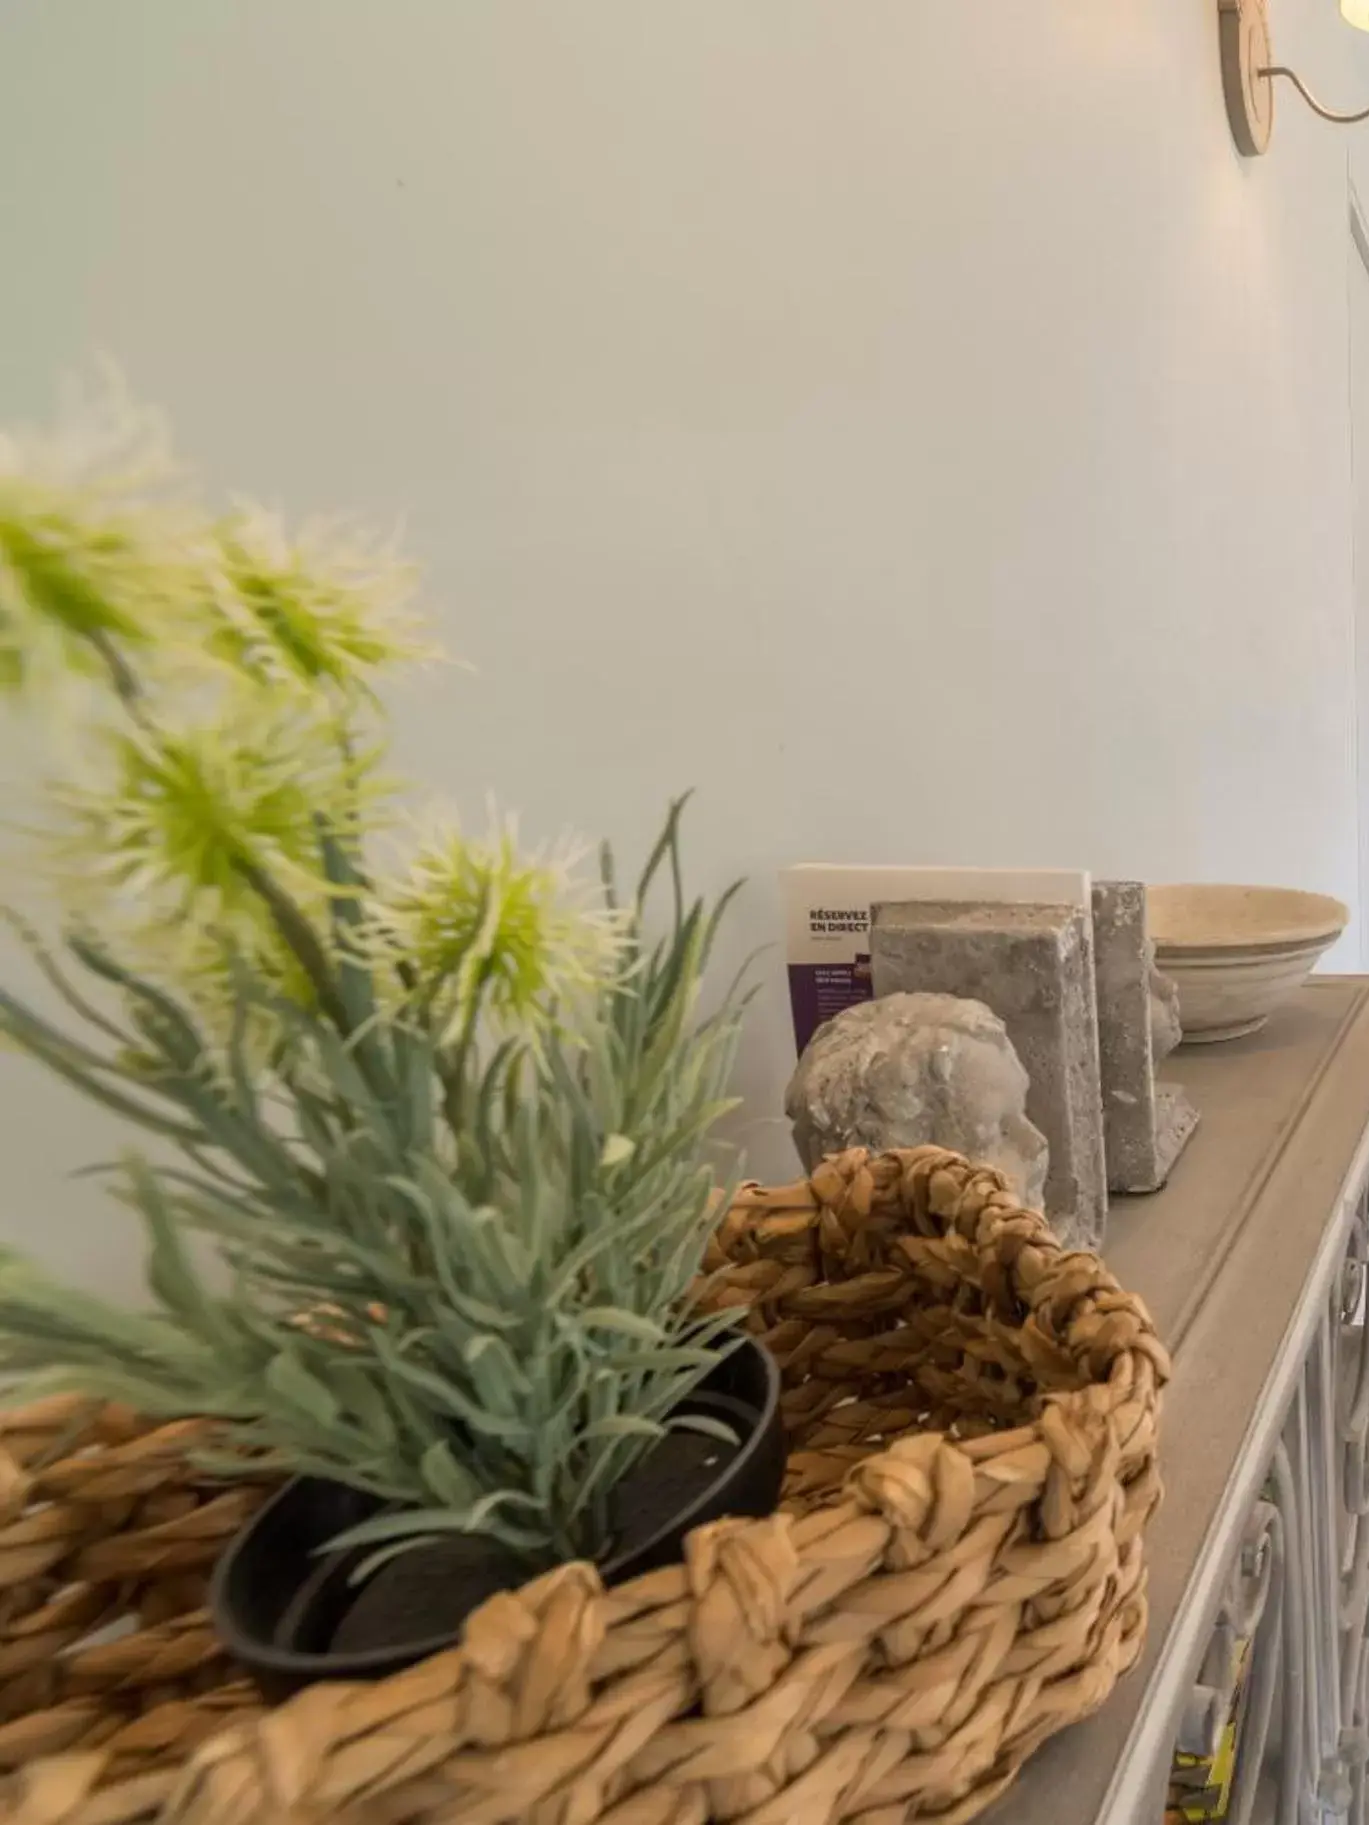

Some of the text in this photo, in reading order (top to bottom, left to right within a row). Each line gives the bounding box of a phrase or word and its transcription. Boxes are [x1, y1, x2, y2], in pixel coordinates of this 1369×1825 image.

[810, 908, 867, 921] RÉSERVEZ
[811, 922, 868, 932] EN DIRECT
